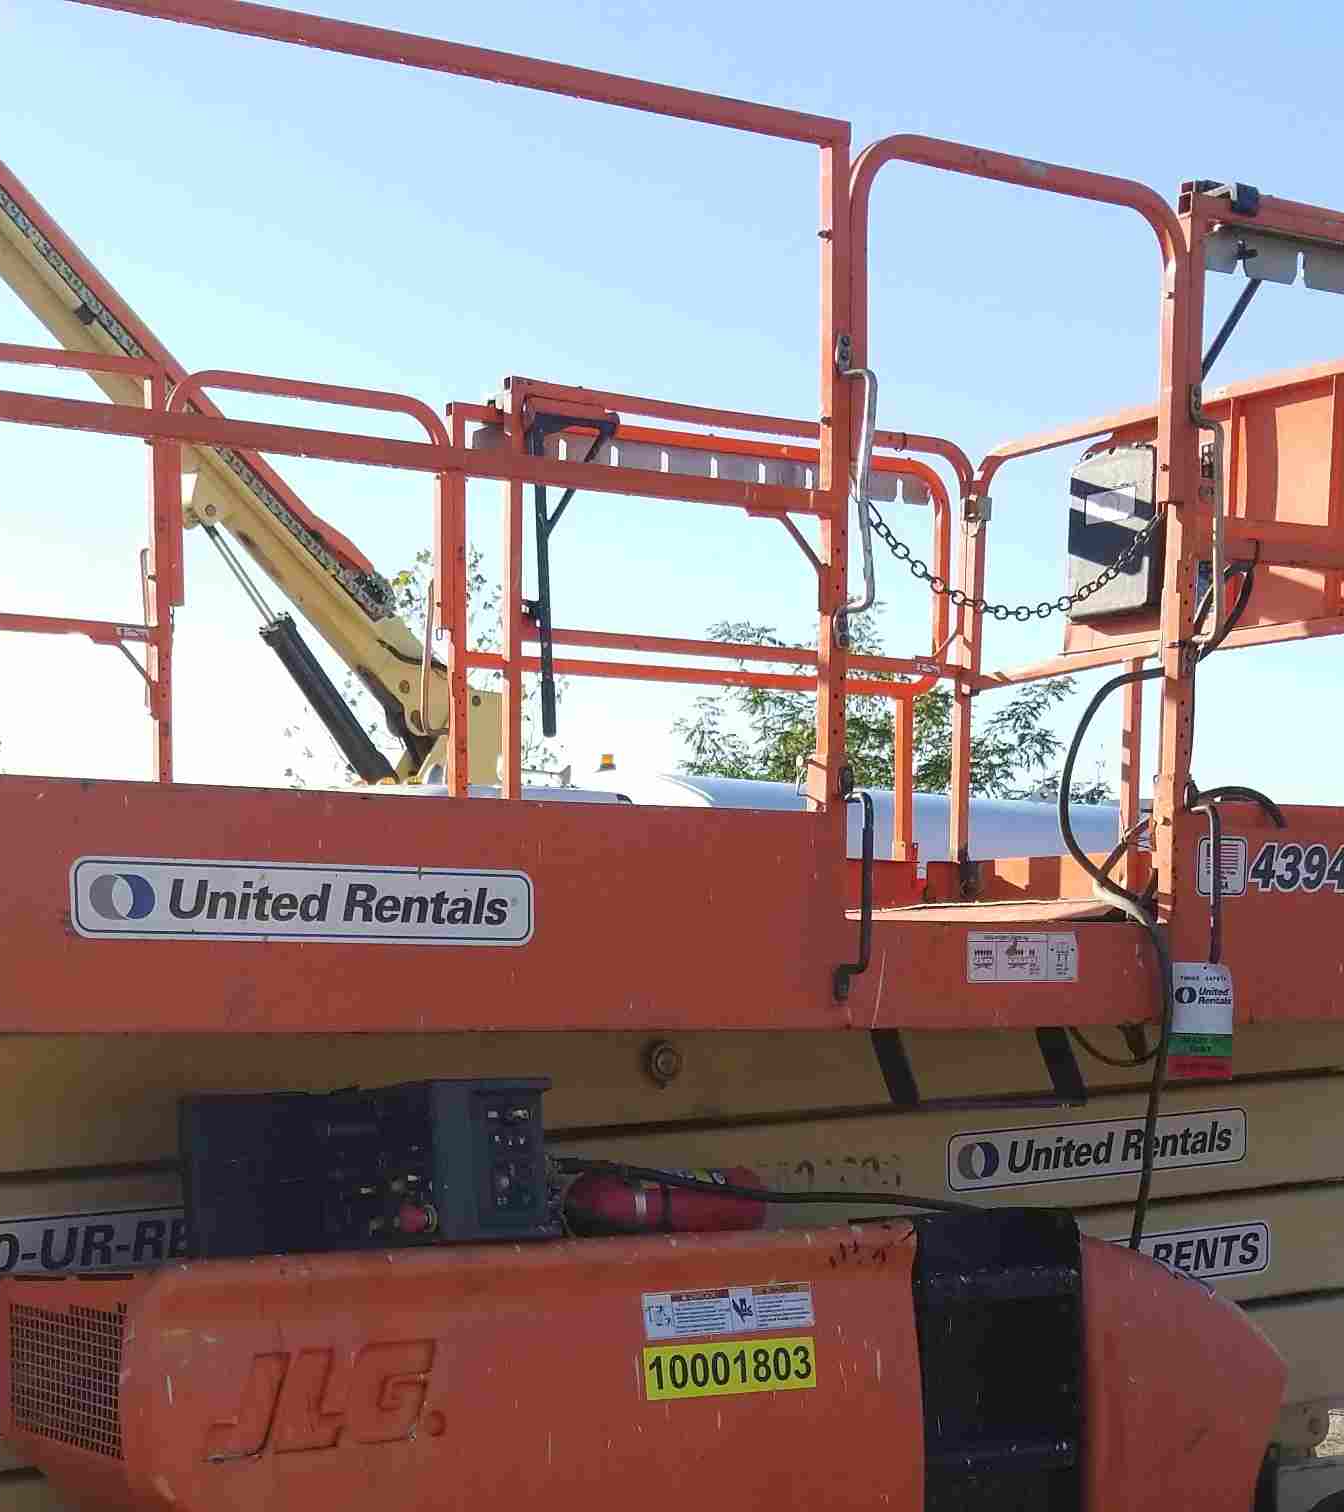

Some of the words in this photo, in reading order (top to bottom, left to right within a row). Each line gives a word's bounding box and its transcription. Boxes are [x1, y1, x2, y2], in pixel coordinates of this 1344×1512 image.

[168, 878, 331, 922] United
[342, 883, 508, 926] Rentals
[1007, 1131, 1113, 1174] United
[1121, 1120, 1232, 1162] Rentals
[1152, 1232, 1260, 1272] RENTS
[649, 1345, 811, 1391] 10001803
